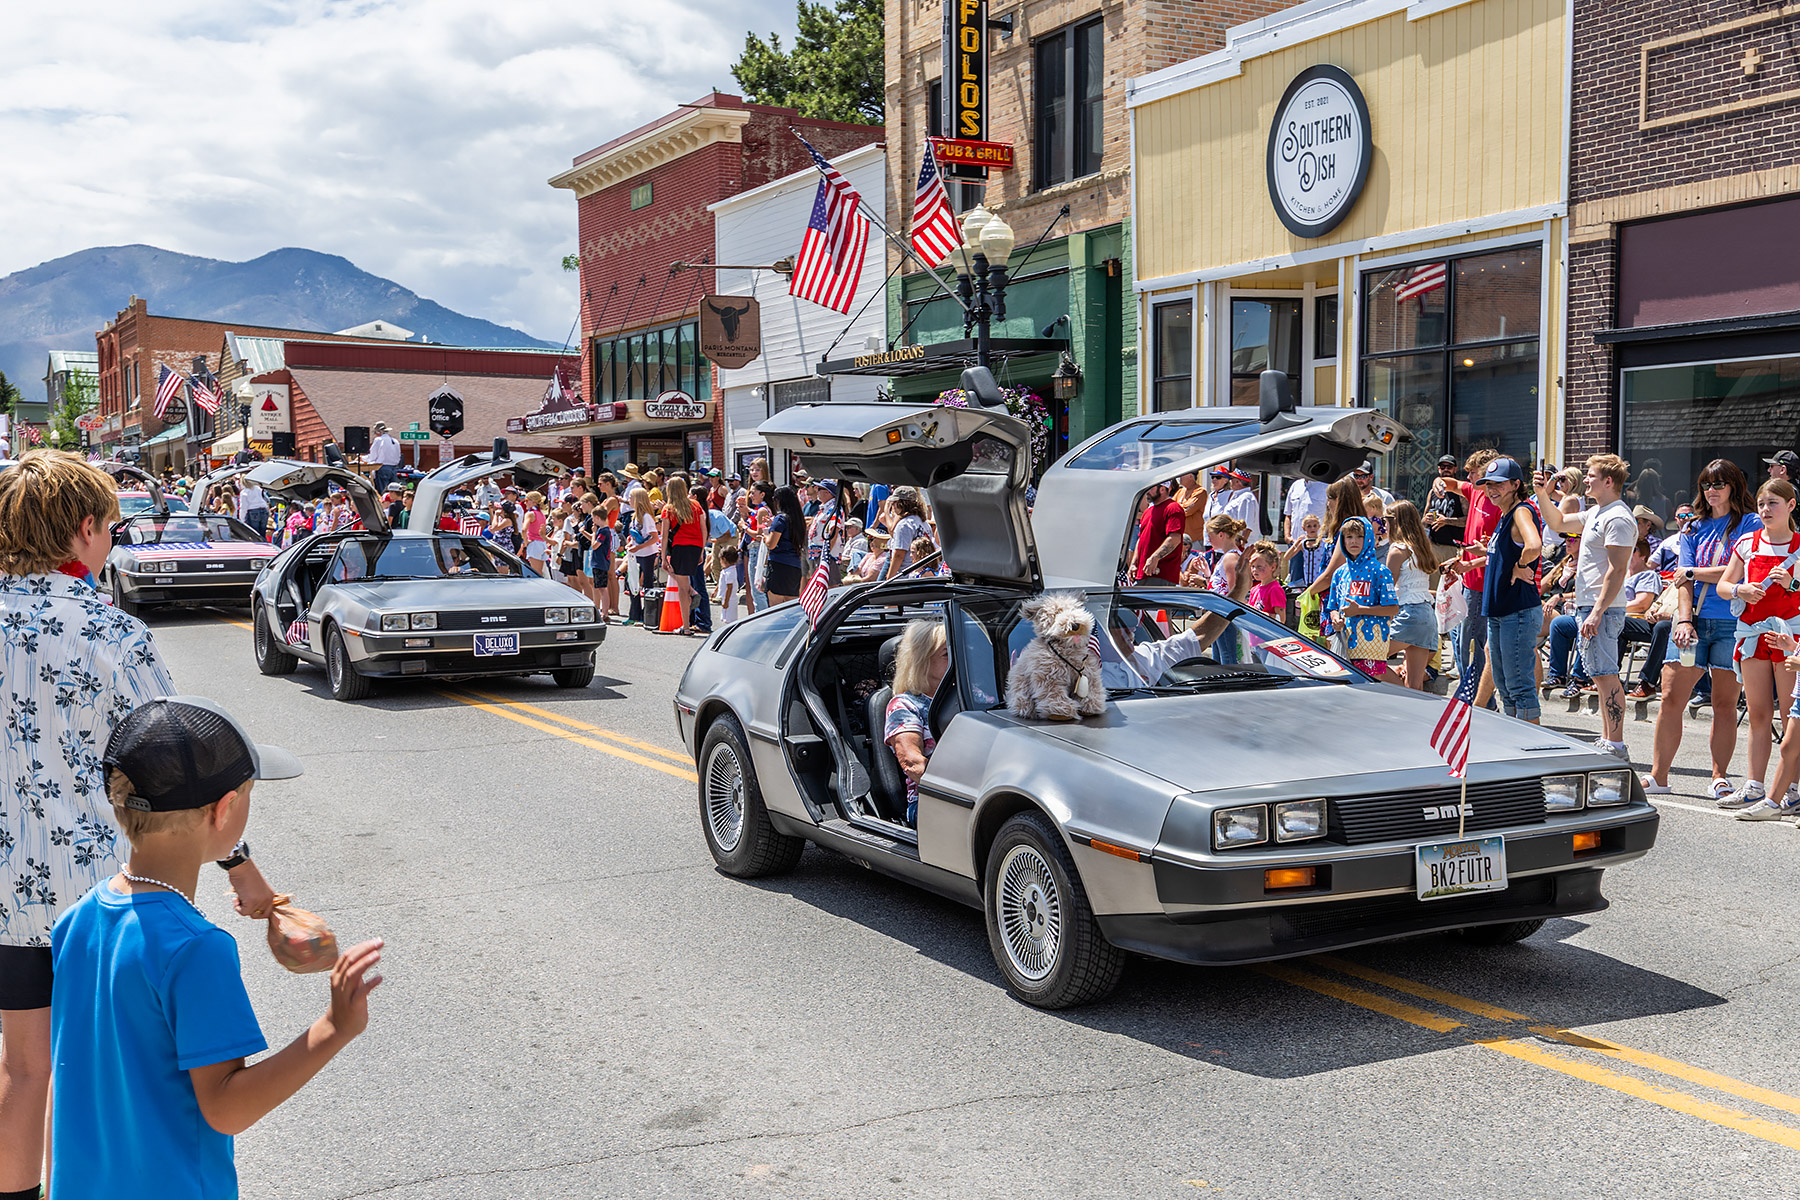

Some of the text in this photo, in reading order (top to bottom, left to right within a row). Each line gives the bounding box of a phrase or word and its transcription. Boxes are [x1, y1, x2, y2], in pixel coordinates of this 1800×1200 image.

[1304, 96, 1329, 109] EST. 2021
[936, 143, 1010, 161] PUB & GRILL
[1290, 196, 1315, 214] KITCHEN
[1324, 186, 1342, 208] HOME
[854, 346, 925, 368] FOSTER & LOGAN'S
[648, 404, 702, 414] GRIZZLY PEAK
[1350, 582, 1371, 596] SZN
[485, 637, 514, 648] DELUXO
[1296, 655, 1326, 668] 185
[1422, 803, 1474, 820] DMC
[1442, 842, 1480, 859] MONTANA
[1431, 856, 1492, 888] BK2FUTR
